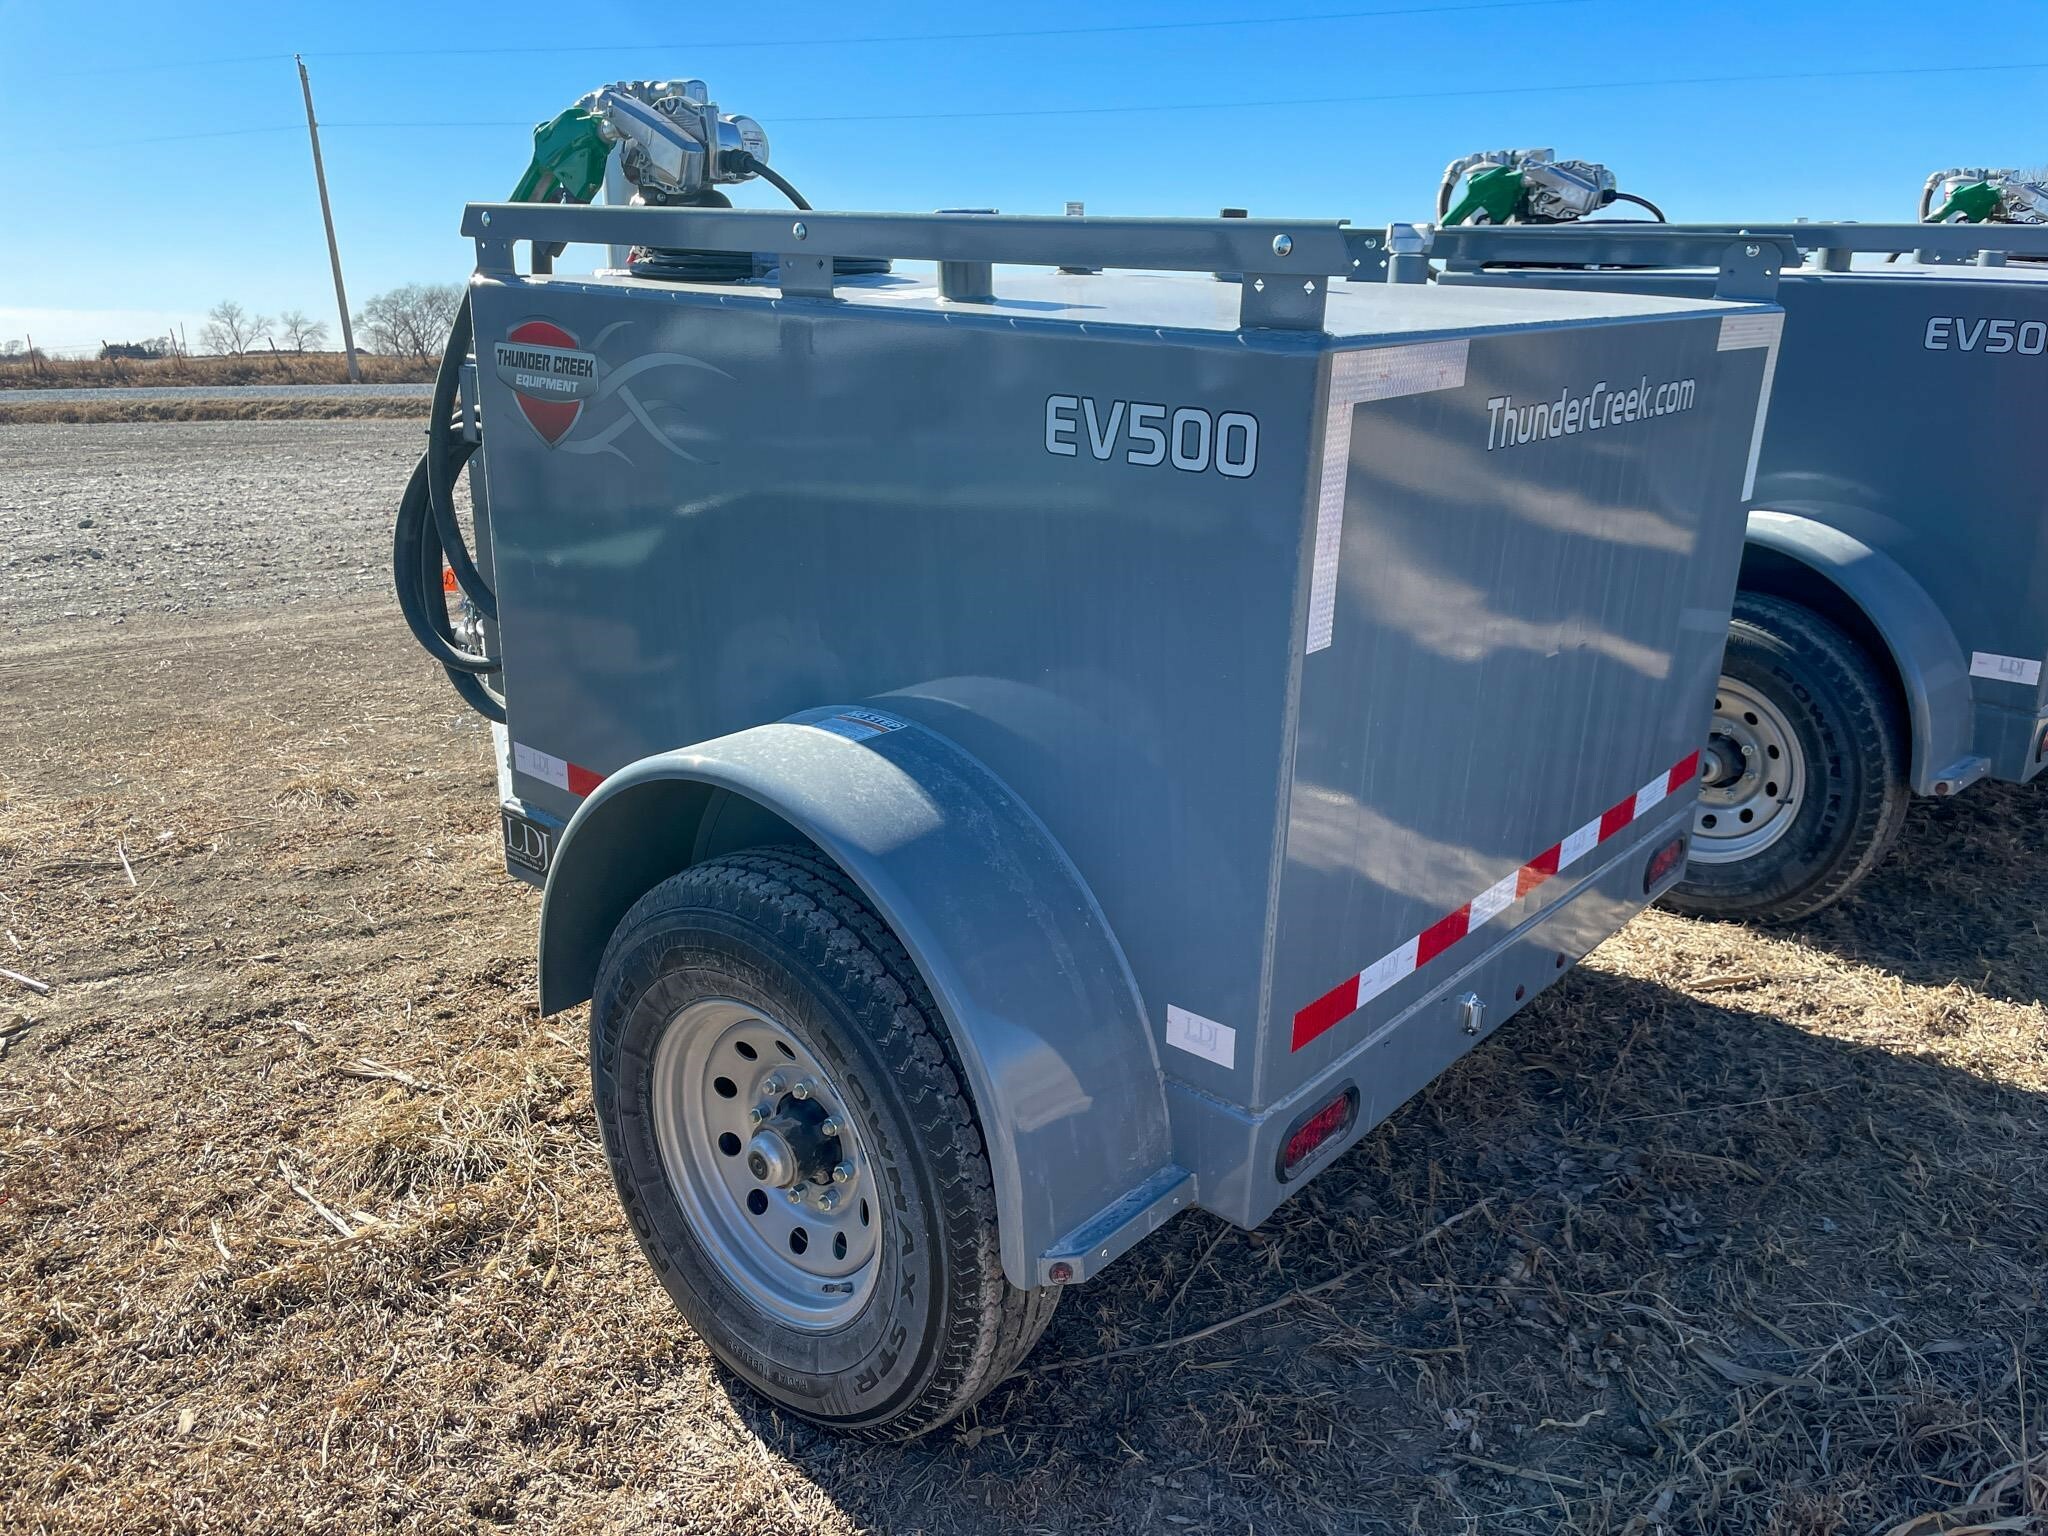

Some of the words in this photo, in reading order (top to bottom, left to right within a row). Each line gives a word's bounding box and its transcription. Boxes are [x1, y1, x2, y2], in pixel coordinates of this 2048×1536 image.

[497, 348, 551, 372] THUNDER
[553, 355, 594, 378] CREEK
[1923, 315, 2048, 356] EV50
[516, 373, 579, 393] EQUIPMENT
[1044, 393, 1260, 480] EV500
[1487, 375, 1696, 451] ThunderCreek.com
[504, 815, 550, 872] LDJ
[1184, 1016, 1218, 1051] LDJ
[819, 1027, 915, 1305] TOWMAX
[853, 1320, 908, 1397] STR
